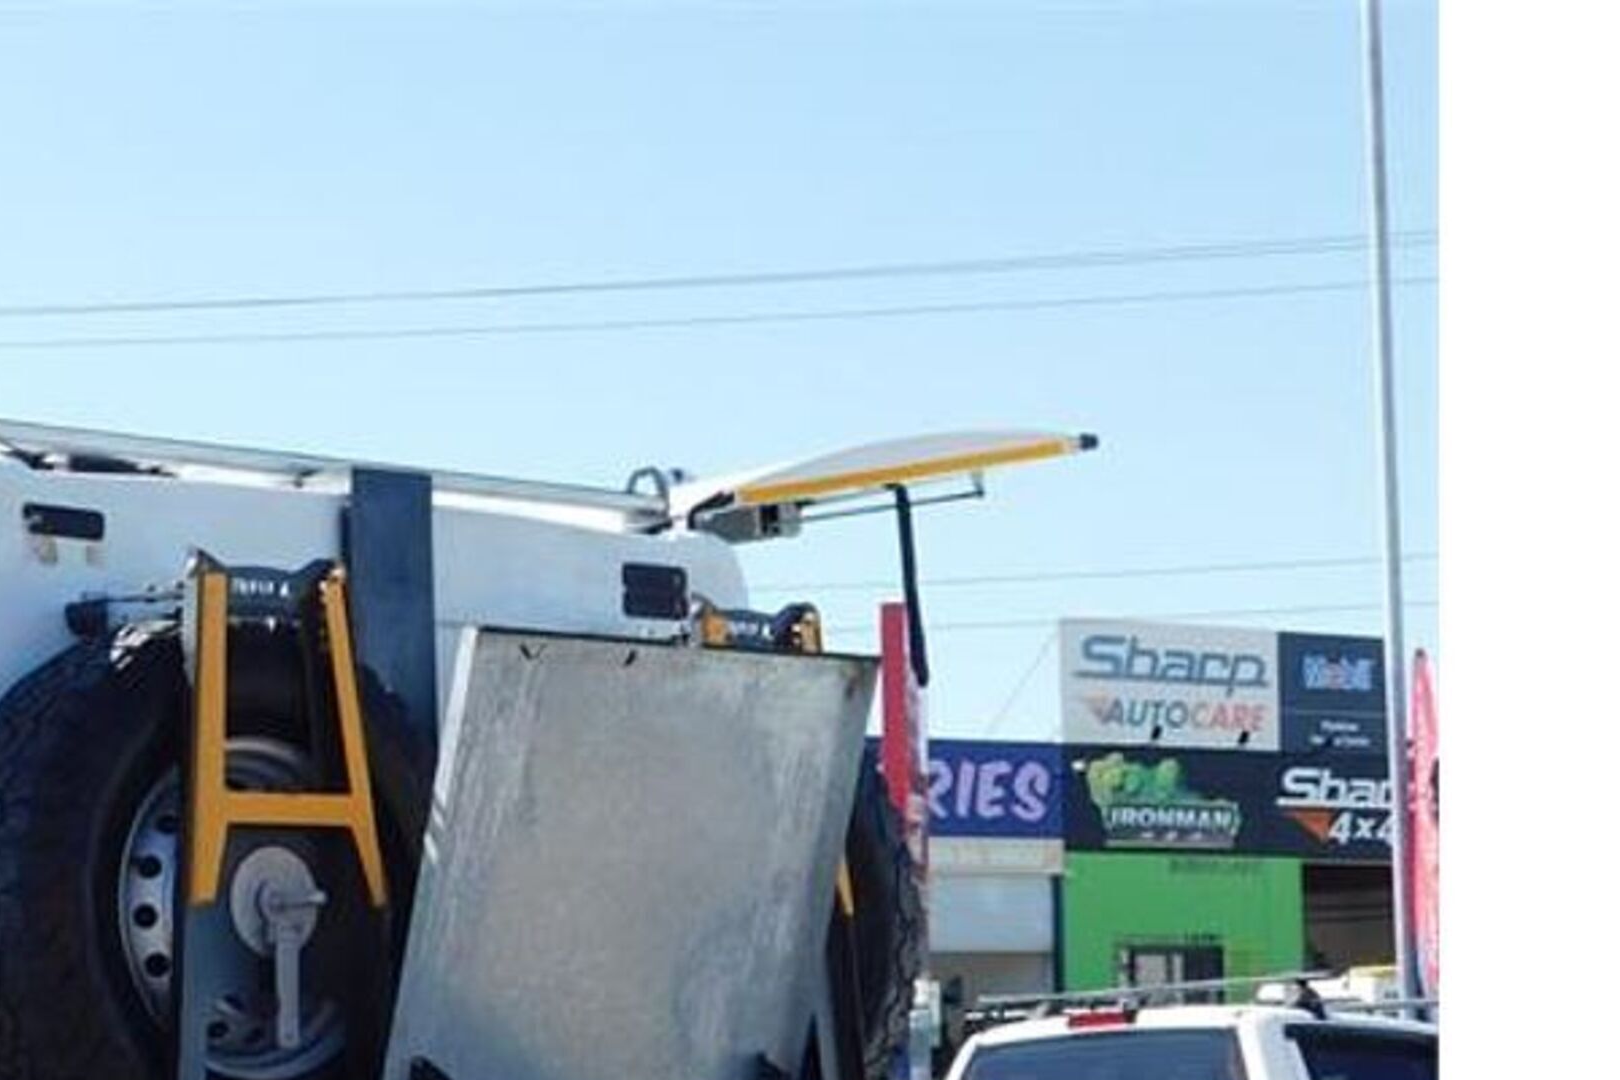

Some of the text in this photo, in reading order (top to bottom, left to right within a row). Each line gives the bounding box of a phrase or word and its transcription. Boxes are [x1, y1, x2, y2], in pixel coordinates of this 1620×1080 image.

[1076, 635, 1267, 697] Sharp
[1101, 698, 1267, 732] AUTOCARE
[1111, 806, 1234, 830] IRONMAN
